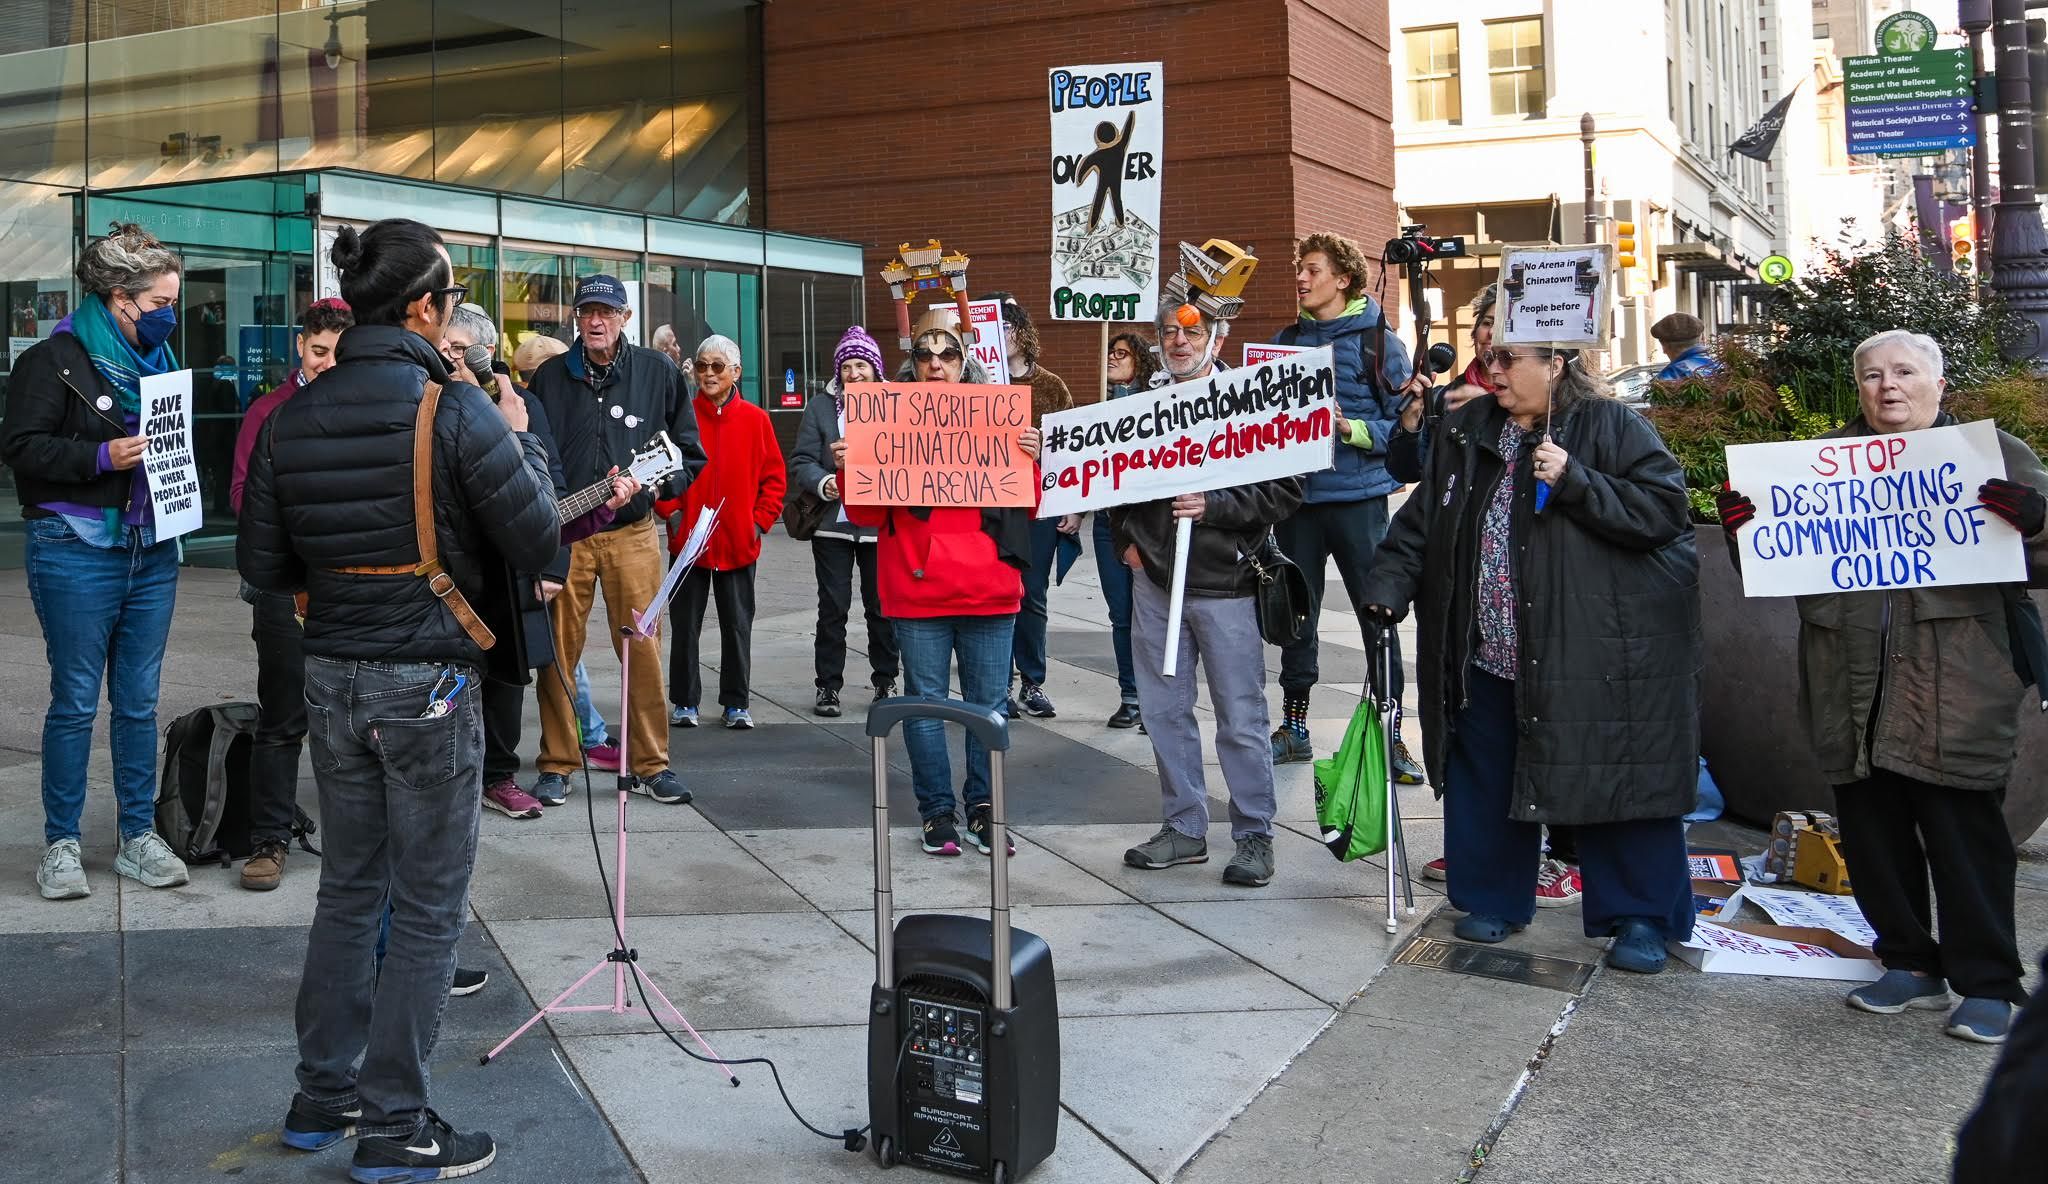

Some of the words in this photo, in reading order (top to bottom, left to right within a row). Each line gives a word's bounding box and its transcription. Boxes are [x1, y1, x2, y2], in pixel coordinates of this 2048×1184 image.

[1849, 57, 1880, 66] Merriam
[1883, 55, 1913, 63] Theater
[1849, 69, 1885, 78] Academy
[1897, 66, 1920, 74] Music
[1050, 69, 1153, 114] PEOPLE
[1850, 82, 1875, 91] Shops
[1886, 80, 1900, 88] the
[1902, 78, 1936, 87] Bellevue
[1850, 92, 1913, 103] Chestnut/Walnut
[1914, 89, 1953, 98] Shopping
[1851, 118, 1885, 128] Historical
[1885, 115, 1940, 125] Society/Library
[1940, 113, 1953, 121] Co.
[1852, 131, 1876, 140] Wilma
[1876, 130, 1905, 138] Theater
[1524, 262, 1537, 271] No
[1538, 261, 1566, 270] Arena
[1566, 259, 1576, 267] in
[1525, 275, 1574, 286] Chinatown
[1053, 286, 1142, 321] PROFIT
[1519, 303, 1549, 315] People
[1550, 302, 1581, 312] before
[1535, 318, 1564, 328] Profits
[1248, 350, 1264, 359] STOP
[151, 393, 182, 417] SAVE
[846, 388, 902, 425] DON'T
[909, 391, 1025, 428] SACRIFICE
[145, 412, 186, 437] CHINA
[147, 431, 186, 456] TOWN
[874, 430, 1011, 468] CHINATOWN
[147, 460, 158, 475] NO
[157, 459, 171, 473] NEW
[171, 454, 193, 469] ARENA
[1810, 437, 1907, 477] STOP
[159, 469, 187, 487] WHERE
[878, 468, 910, 502] NO
[920, 470, 998, 504] ARENA
[154, 485, 183, 504] PEOPLE
[182, 480, 198, 494] ARE
[1770, 462, 1964, 518] DESTROYING
[164, 496, 192, 516] LIVING!
[1752, 509, 1936, 561] COMMUNITIES
[1944, 504, 1988, 546] OF
[1831, 548, 1937, 590] COLOR
[920, 1106, 973, 1121] EUROPORT
